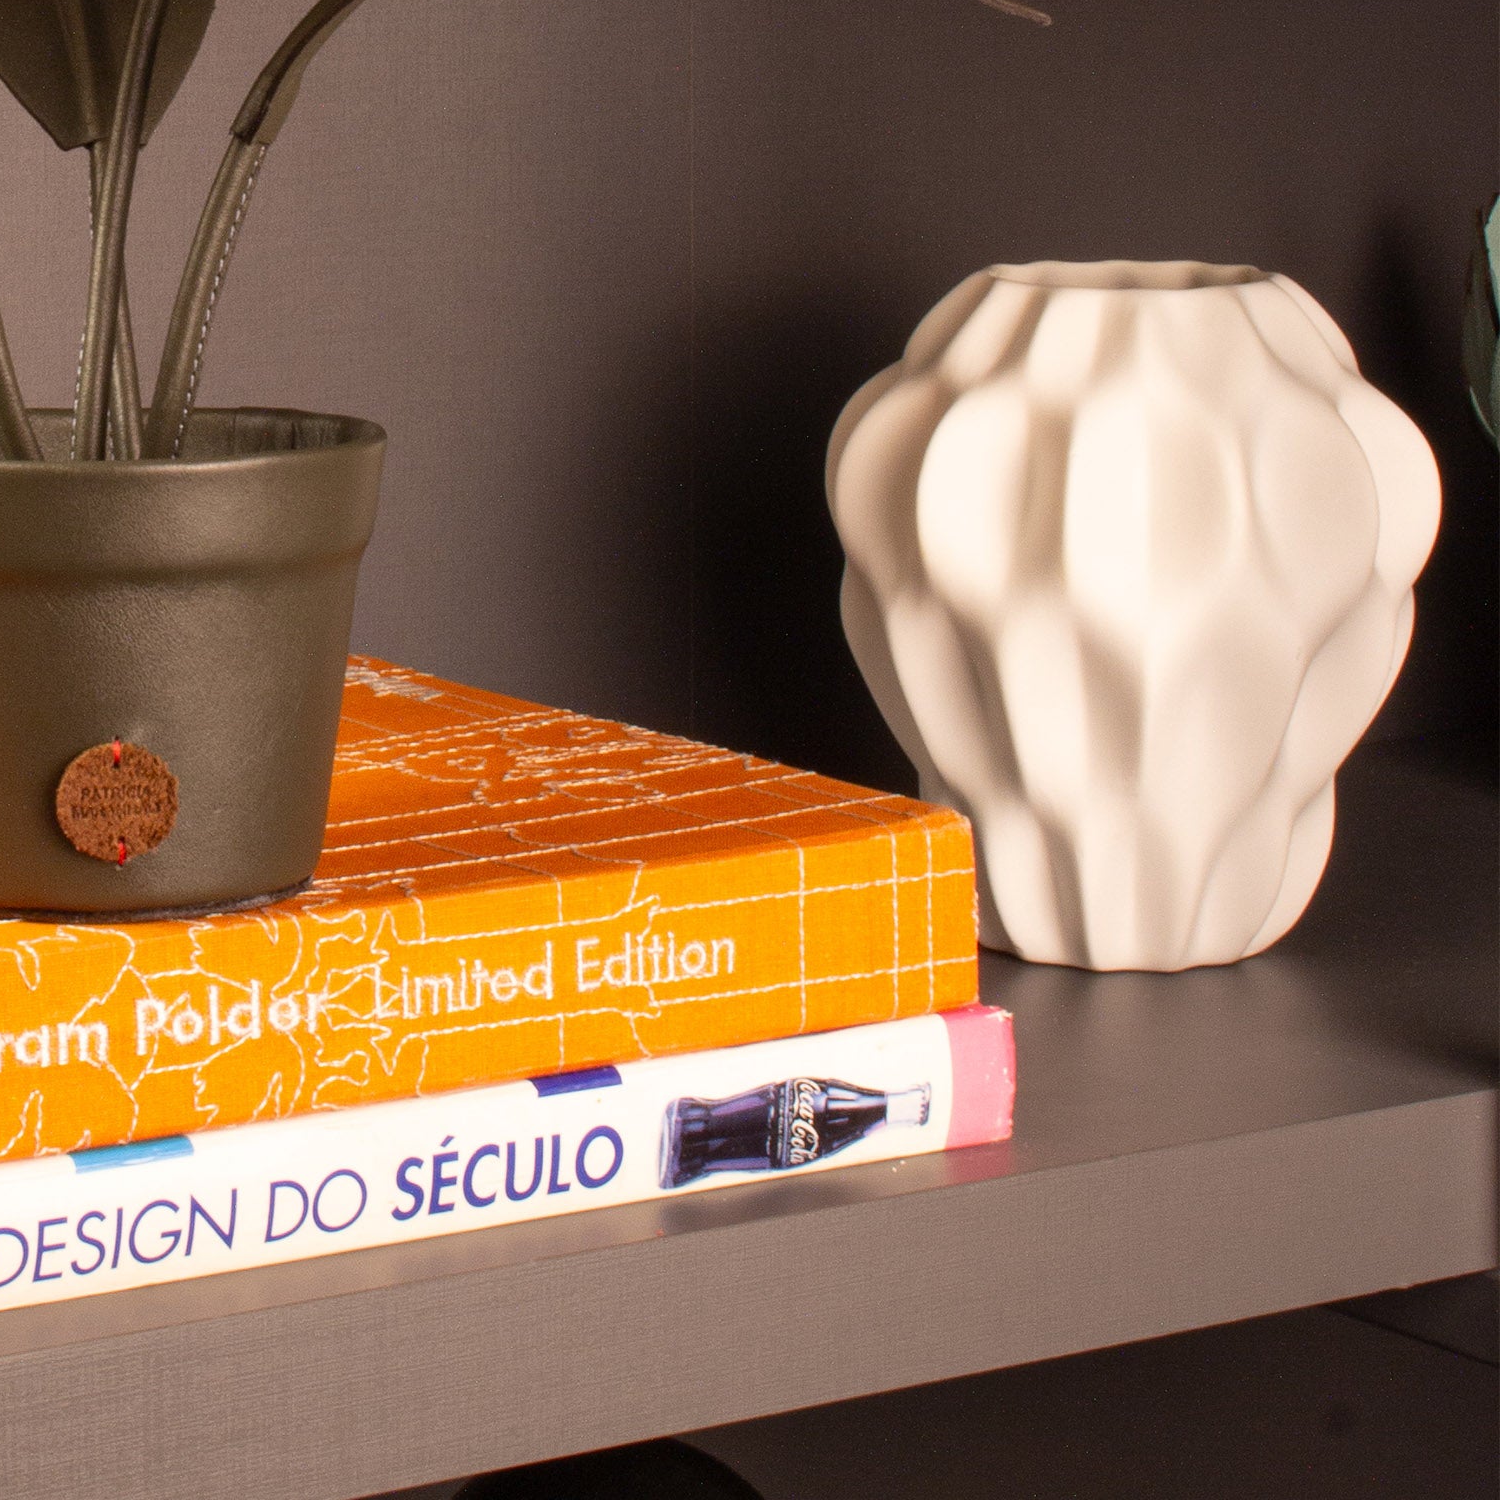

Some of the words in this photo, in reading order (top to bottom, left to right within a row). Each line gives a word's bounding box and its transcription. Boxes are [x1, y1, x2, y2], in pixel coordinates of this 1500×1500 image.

[135, 979, 328, 1057] Polder
[374, 940, 552, 1019] Limited
[576, 931, 735, 993] Edition
[265, 1170, 368, 1243] DO
[392, 1126, 624, 1222] SÉCULO
